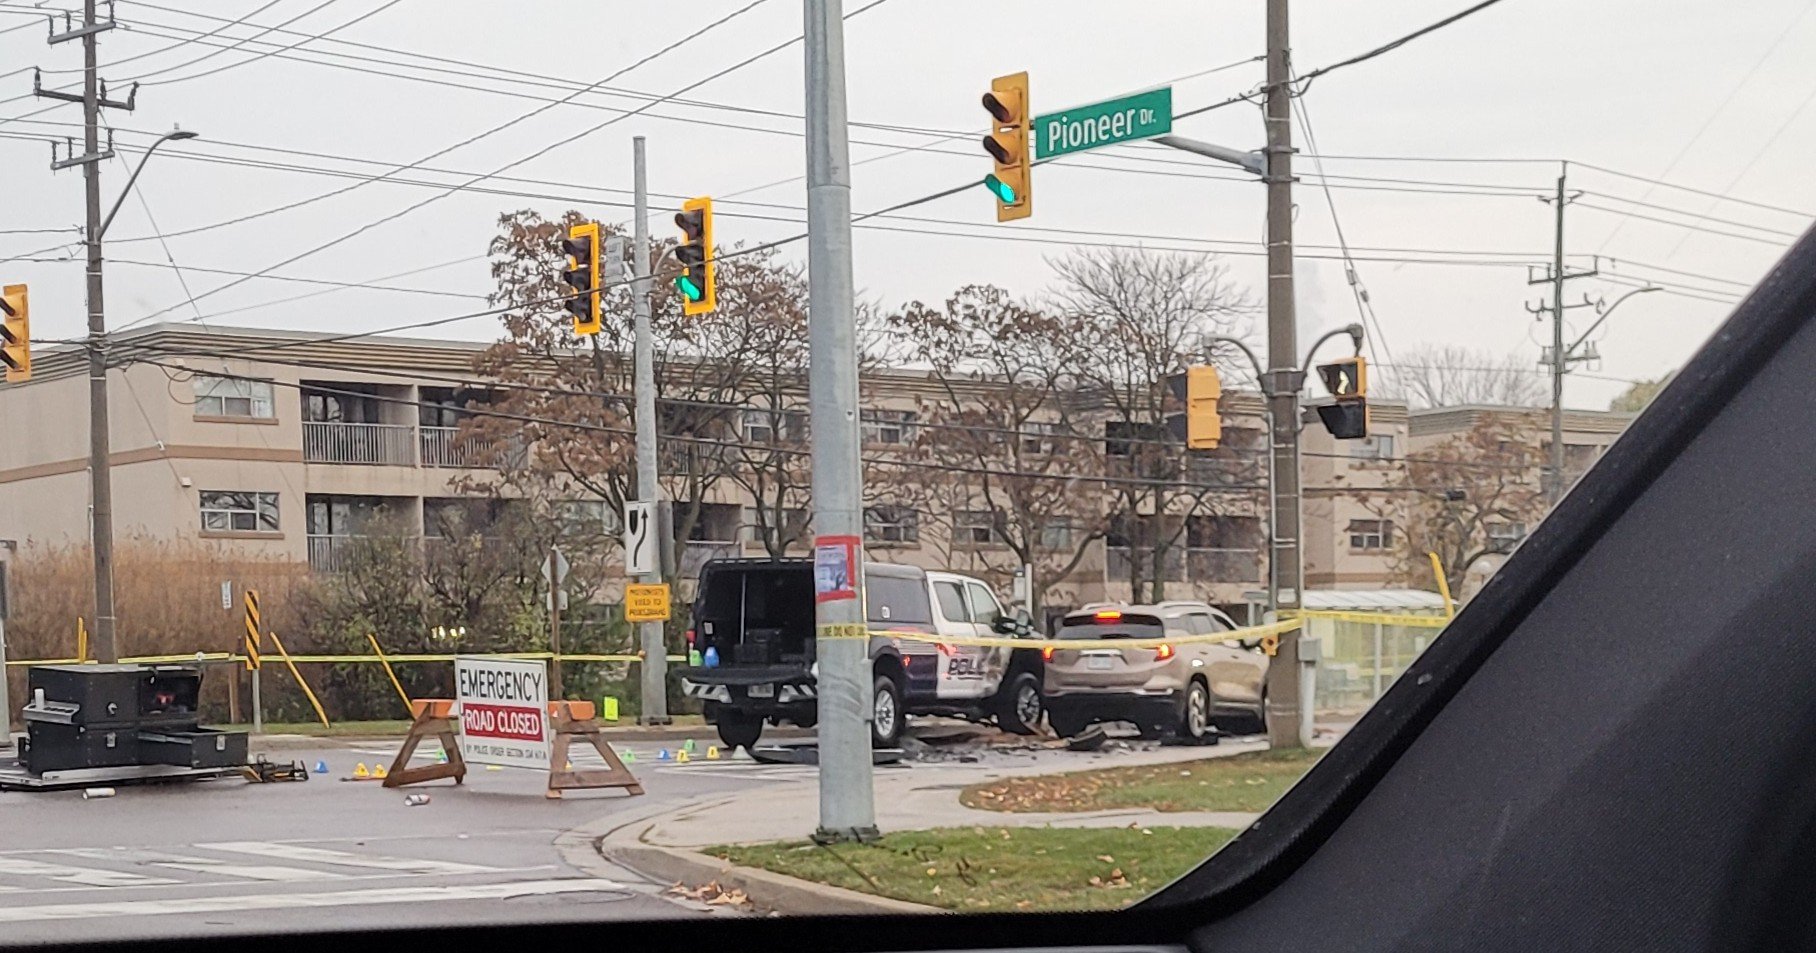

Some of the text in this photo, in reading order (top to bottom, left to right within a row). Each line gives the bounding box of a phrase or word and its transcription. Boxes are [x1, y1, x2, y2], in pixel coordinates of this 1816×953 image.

[1048, 108, 1157, 152] Pioneer Dr.
[460, 668, 542, 702] EMERGENCY
[465, 709, 540, 735] ROAD CLOSED
